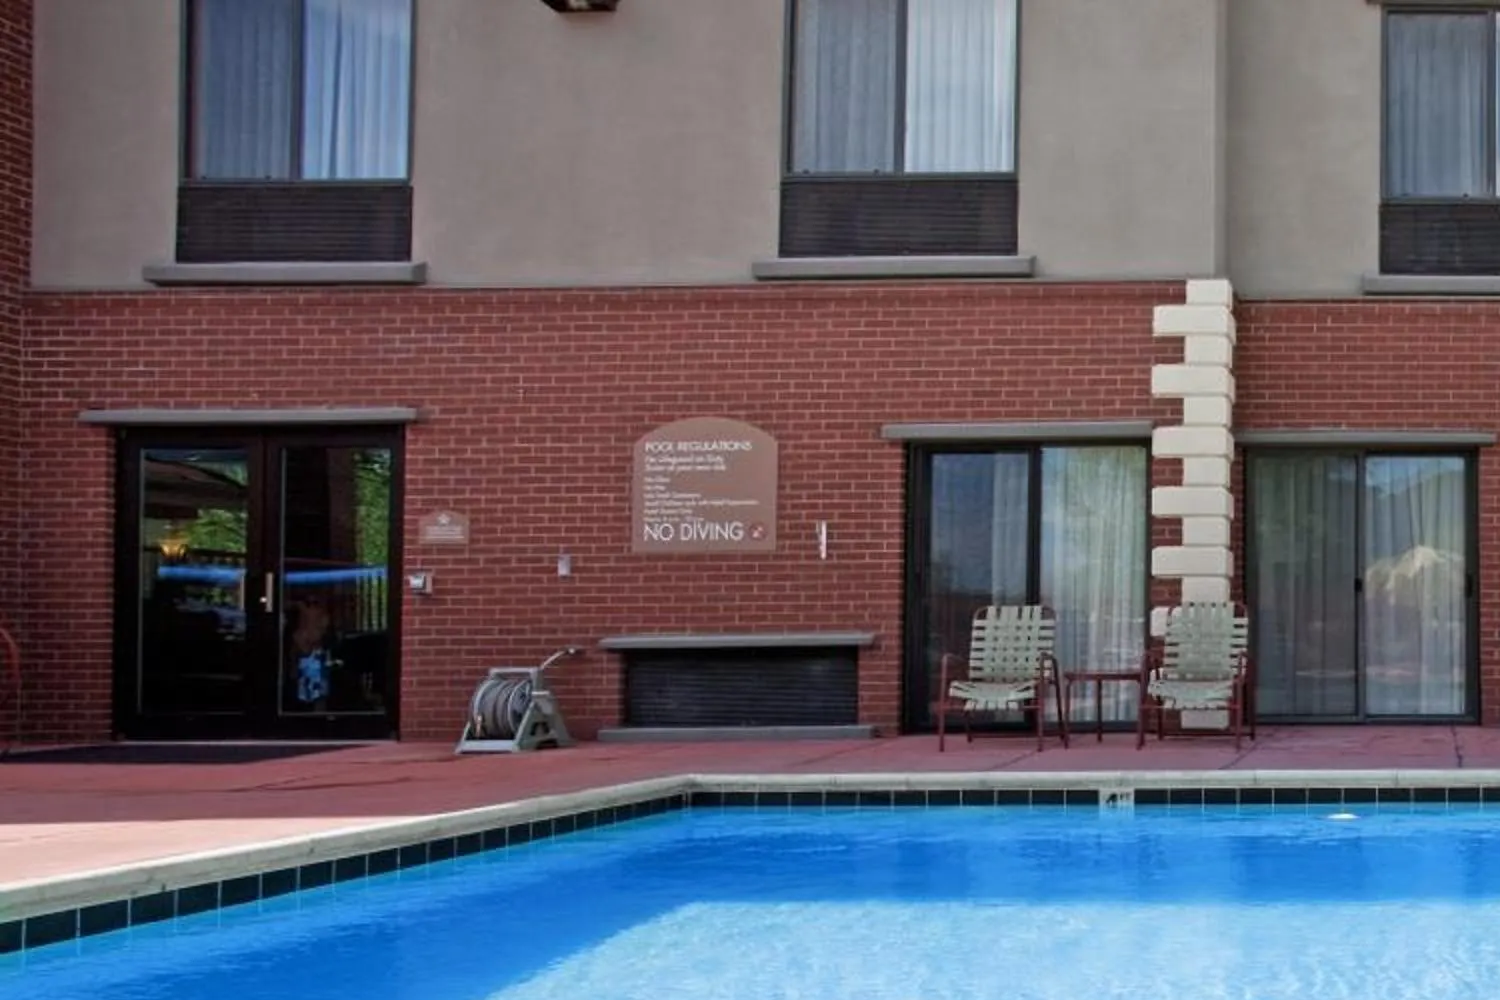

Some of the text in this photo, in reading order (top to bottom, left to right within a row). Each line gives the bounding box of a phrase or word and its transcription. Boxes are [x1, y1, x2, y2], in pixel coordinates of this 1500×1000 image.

[645, 440, 753, 452] POOL REGULATIONS
[643, 520, 744, 541] NO DIVING
